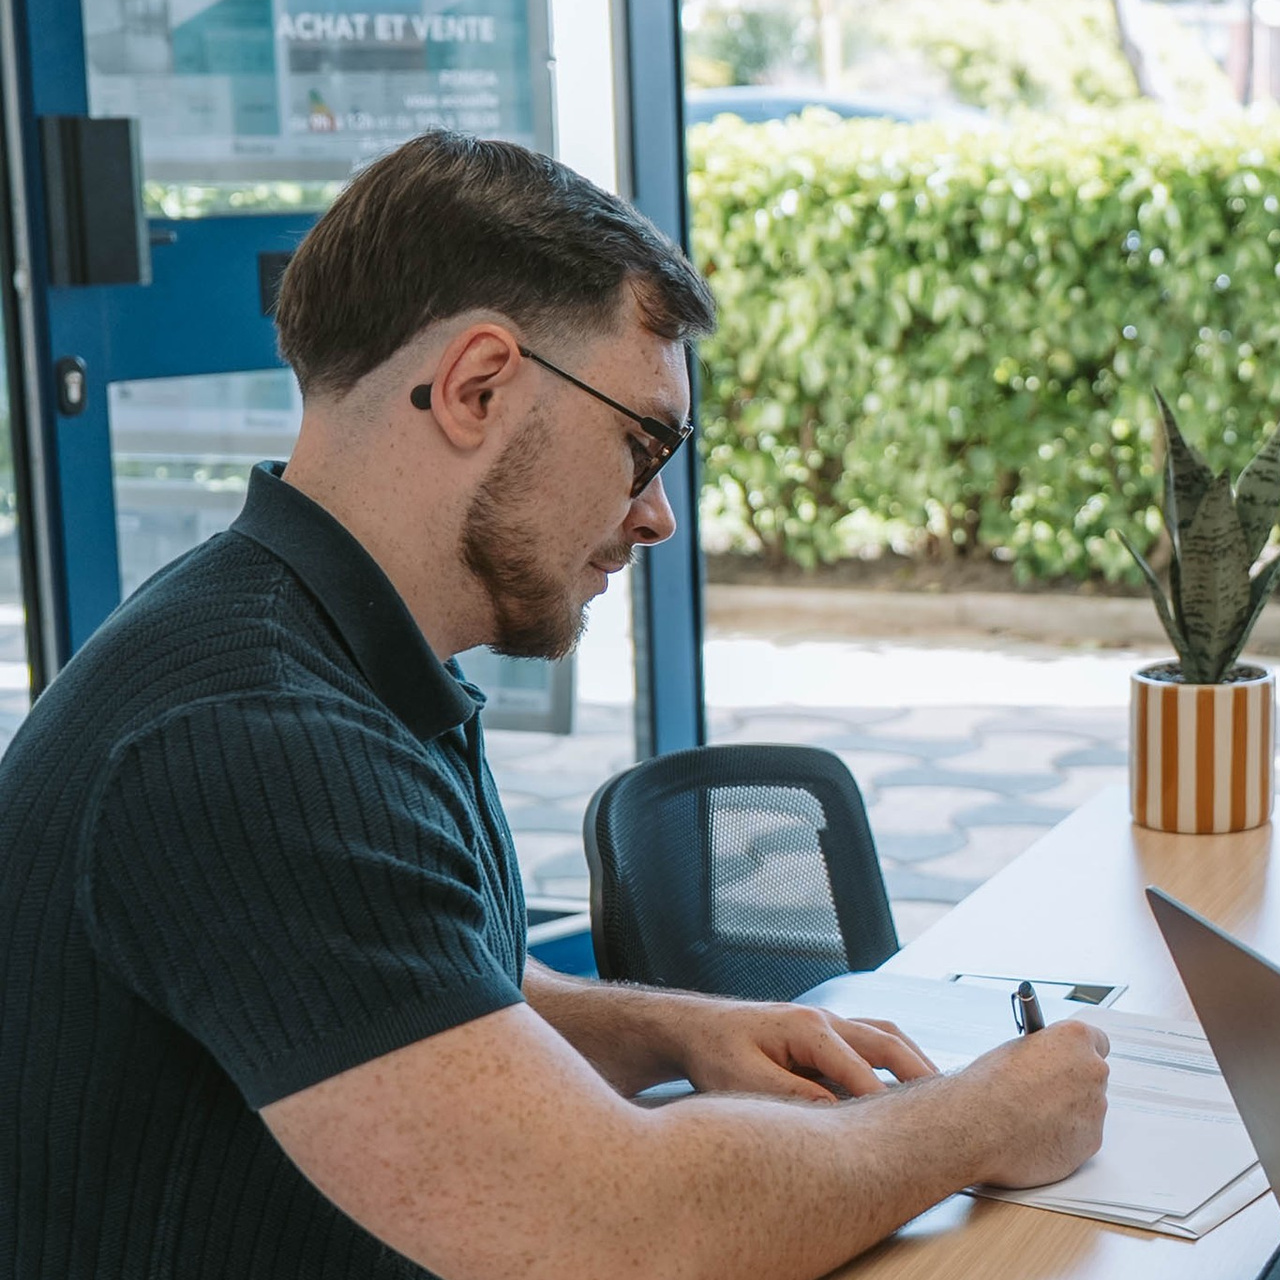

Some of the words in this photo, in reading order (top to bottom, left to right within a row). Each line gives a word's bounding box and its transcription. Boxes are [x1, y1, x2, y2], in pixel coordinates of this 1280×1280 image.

[276, 11, 369, 41] ACHAT
[374, 13, 407, 42] ET
[410, 14, 495, 43] VENTE
